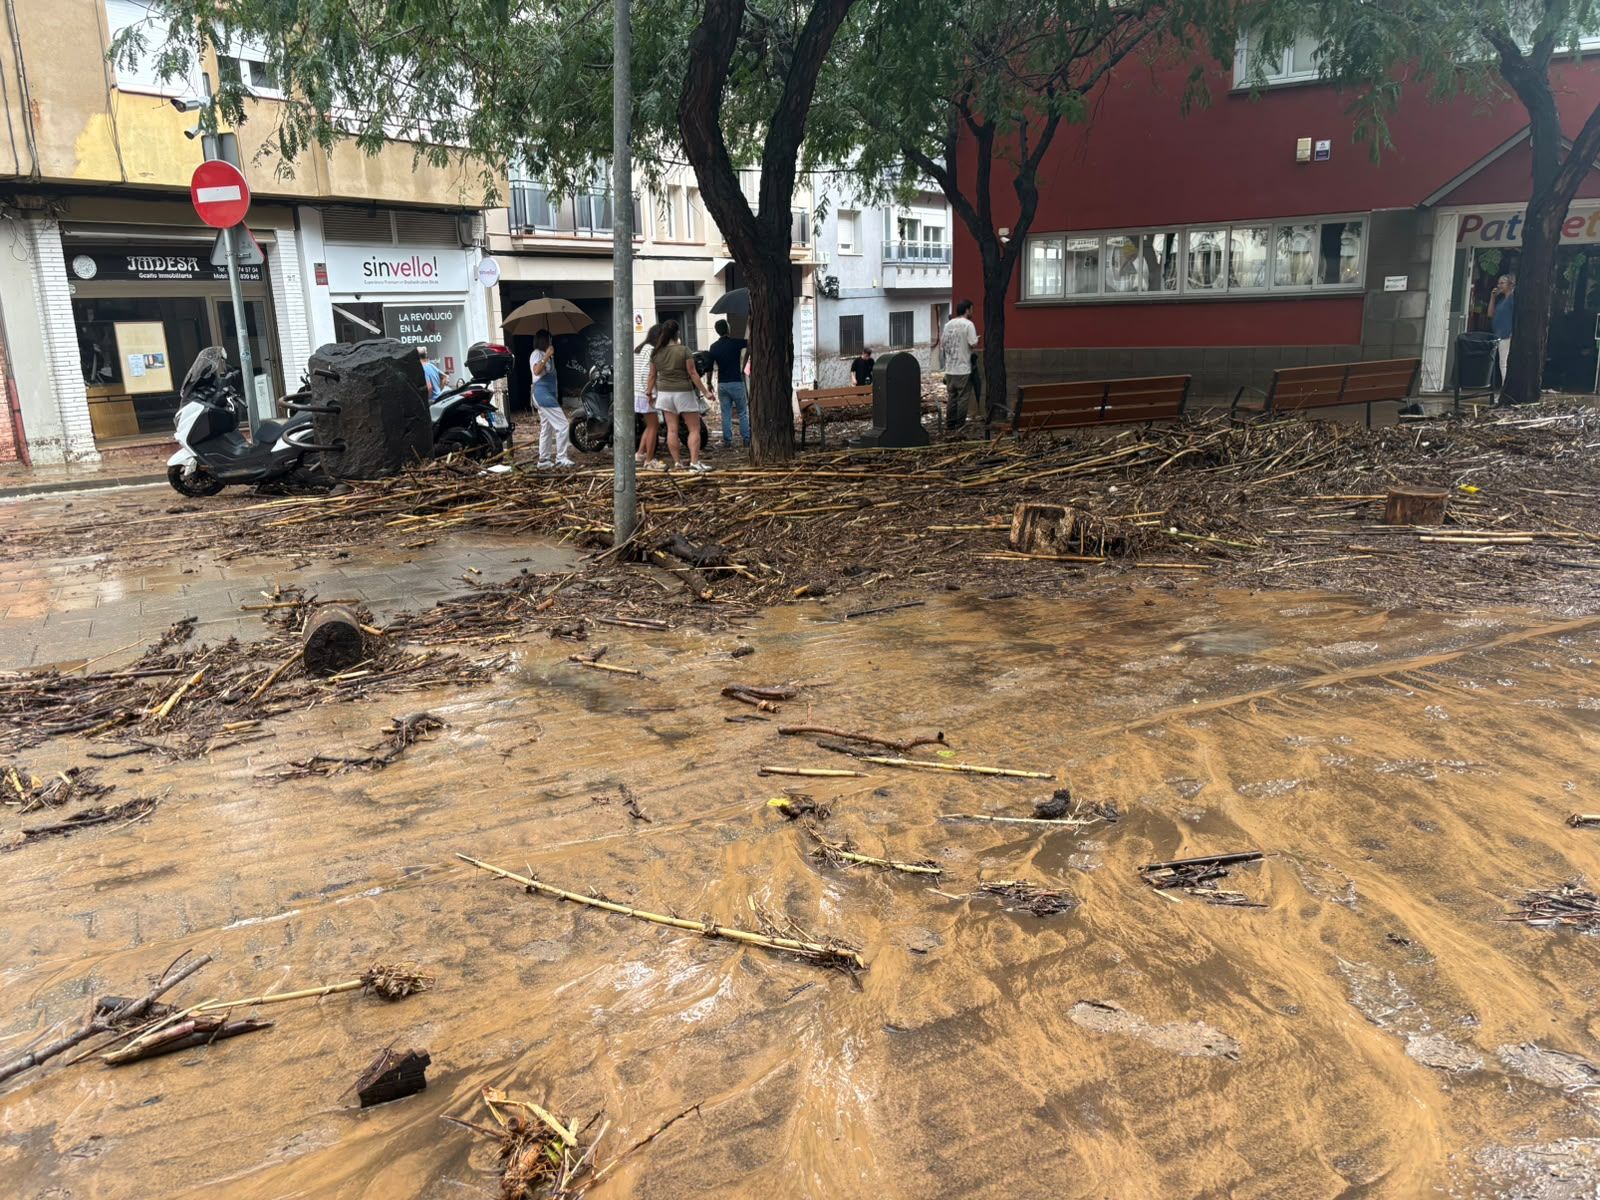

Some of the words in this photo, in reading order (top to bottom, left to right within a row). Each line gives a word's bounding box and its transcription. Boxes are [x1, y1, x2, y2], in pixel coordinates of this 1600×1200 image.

[363, 255, 439, 278] sinvello!
[399, 313, 409, 322] LA
[410, 310, 453, 321] REVOLUCIÓ
[400, 324, 411, 333] EN
[412, 324, 423, 333] LA
[401, 332, 442, 344] DEPILACIÓ
